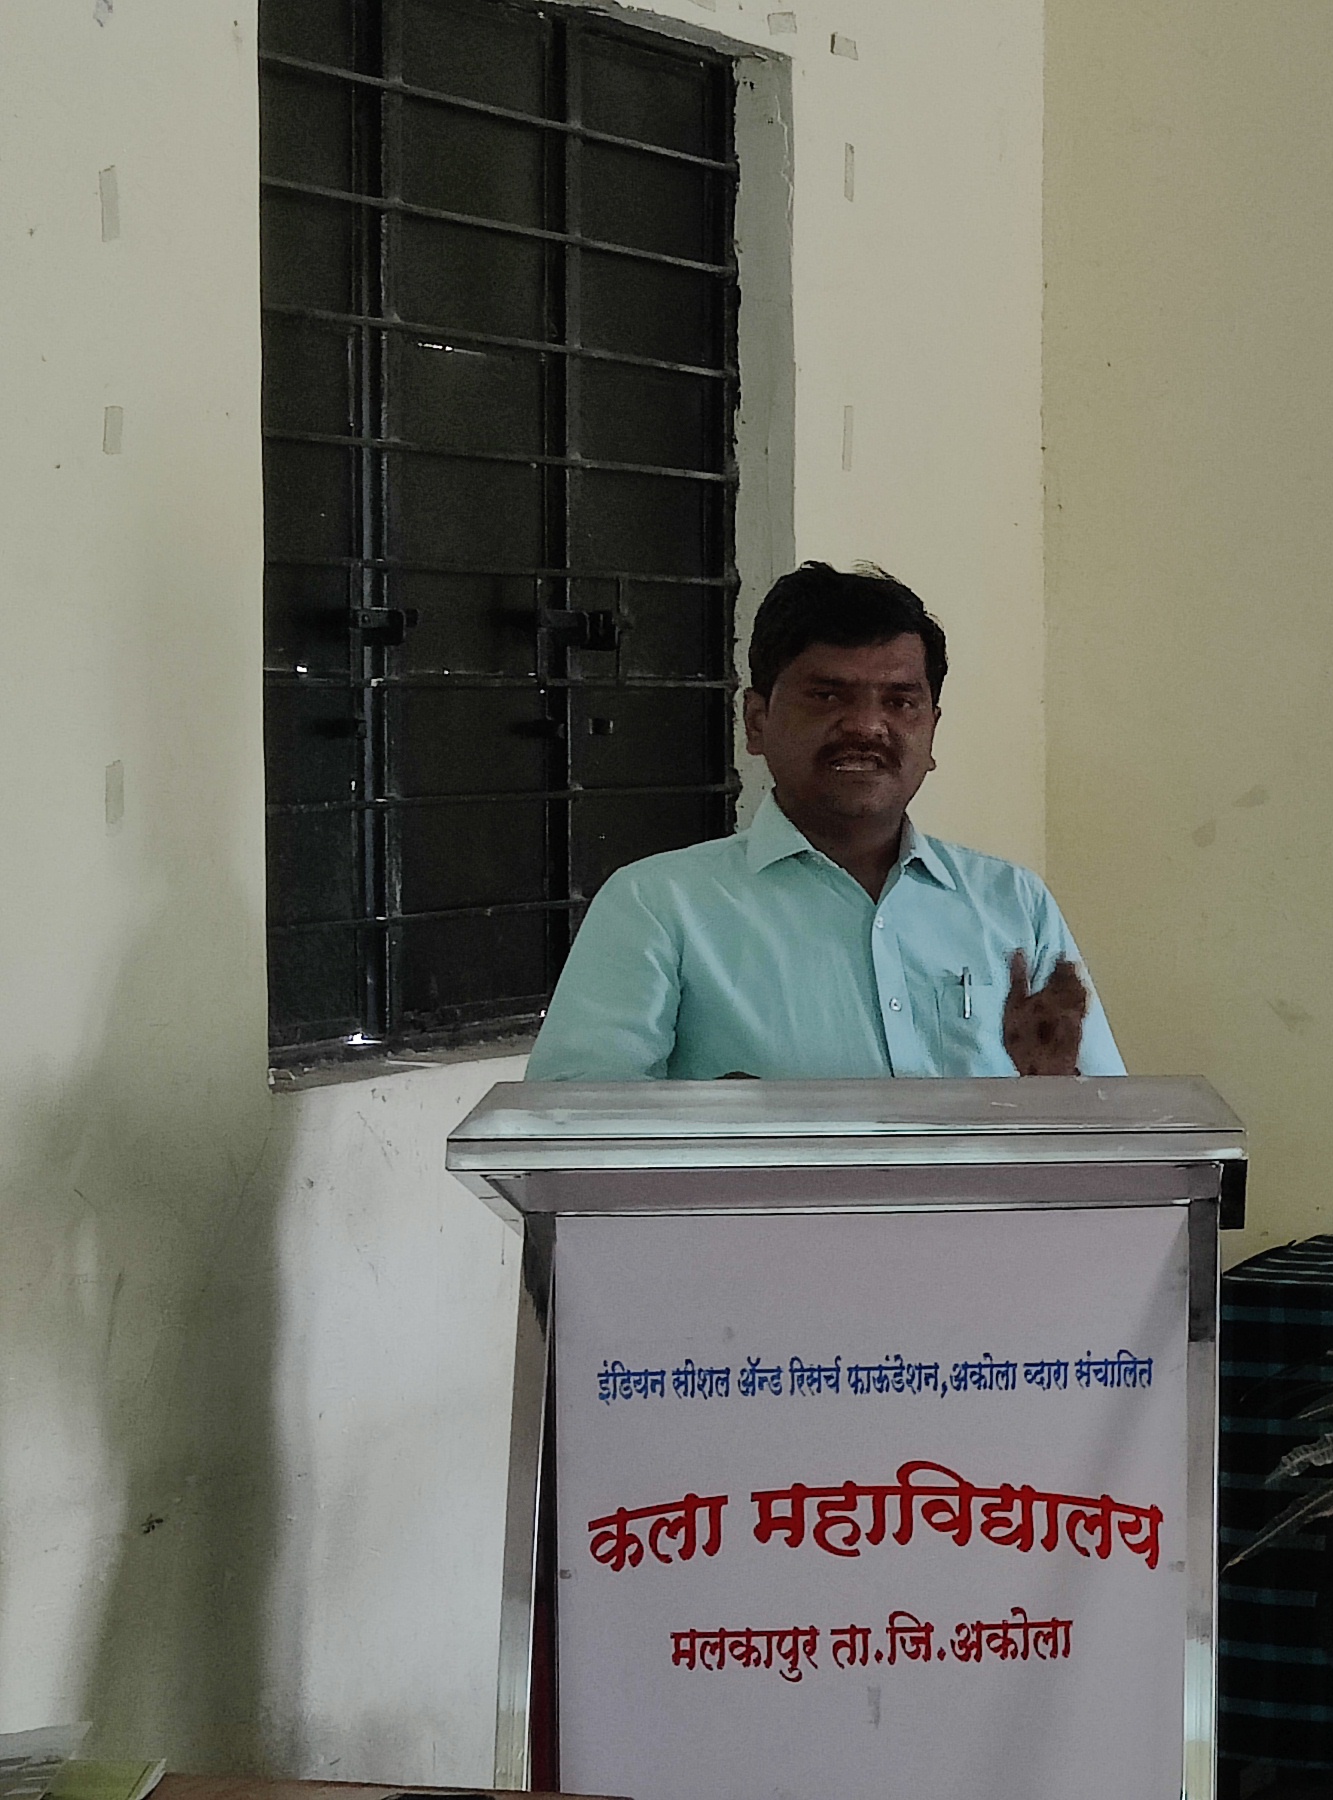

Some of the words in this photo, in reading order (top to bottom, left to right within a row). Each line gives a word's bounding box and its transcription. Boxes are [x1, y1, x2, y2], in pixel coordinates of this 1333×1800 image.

[597, 1359, 667, 1406] इंडियन
[789, 1355, 842, 1397] रिसर्च
[1074, 1348, 1154, 1390] संचालित
[588, 1491, 729, 1573] कला
[750, 1460, 1163, 1571] महाविद्यालय
[670, 1623, 821, 1683] मलकापुर
